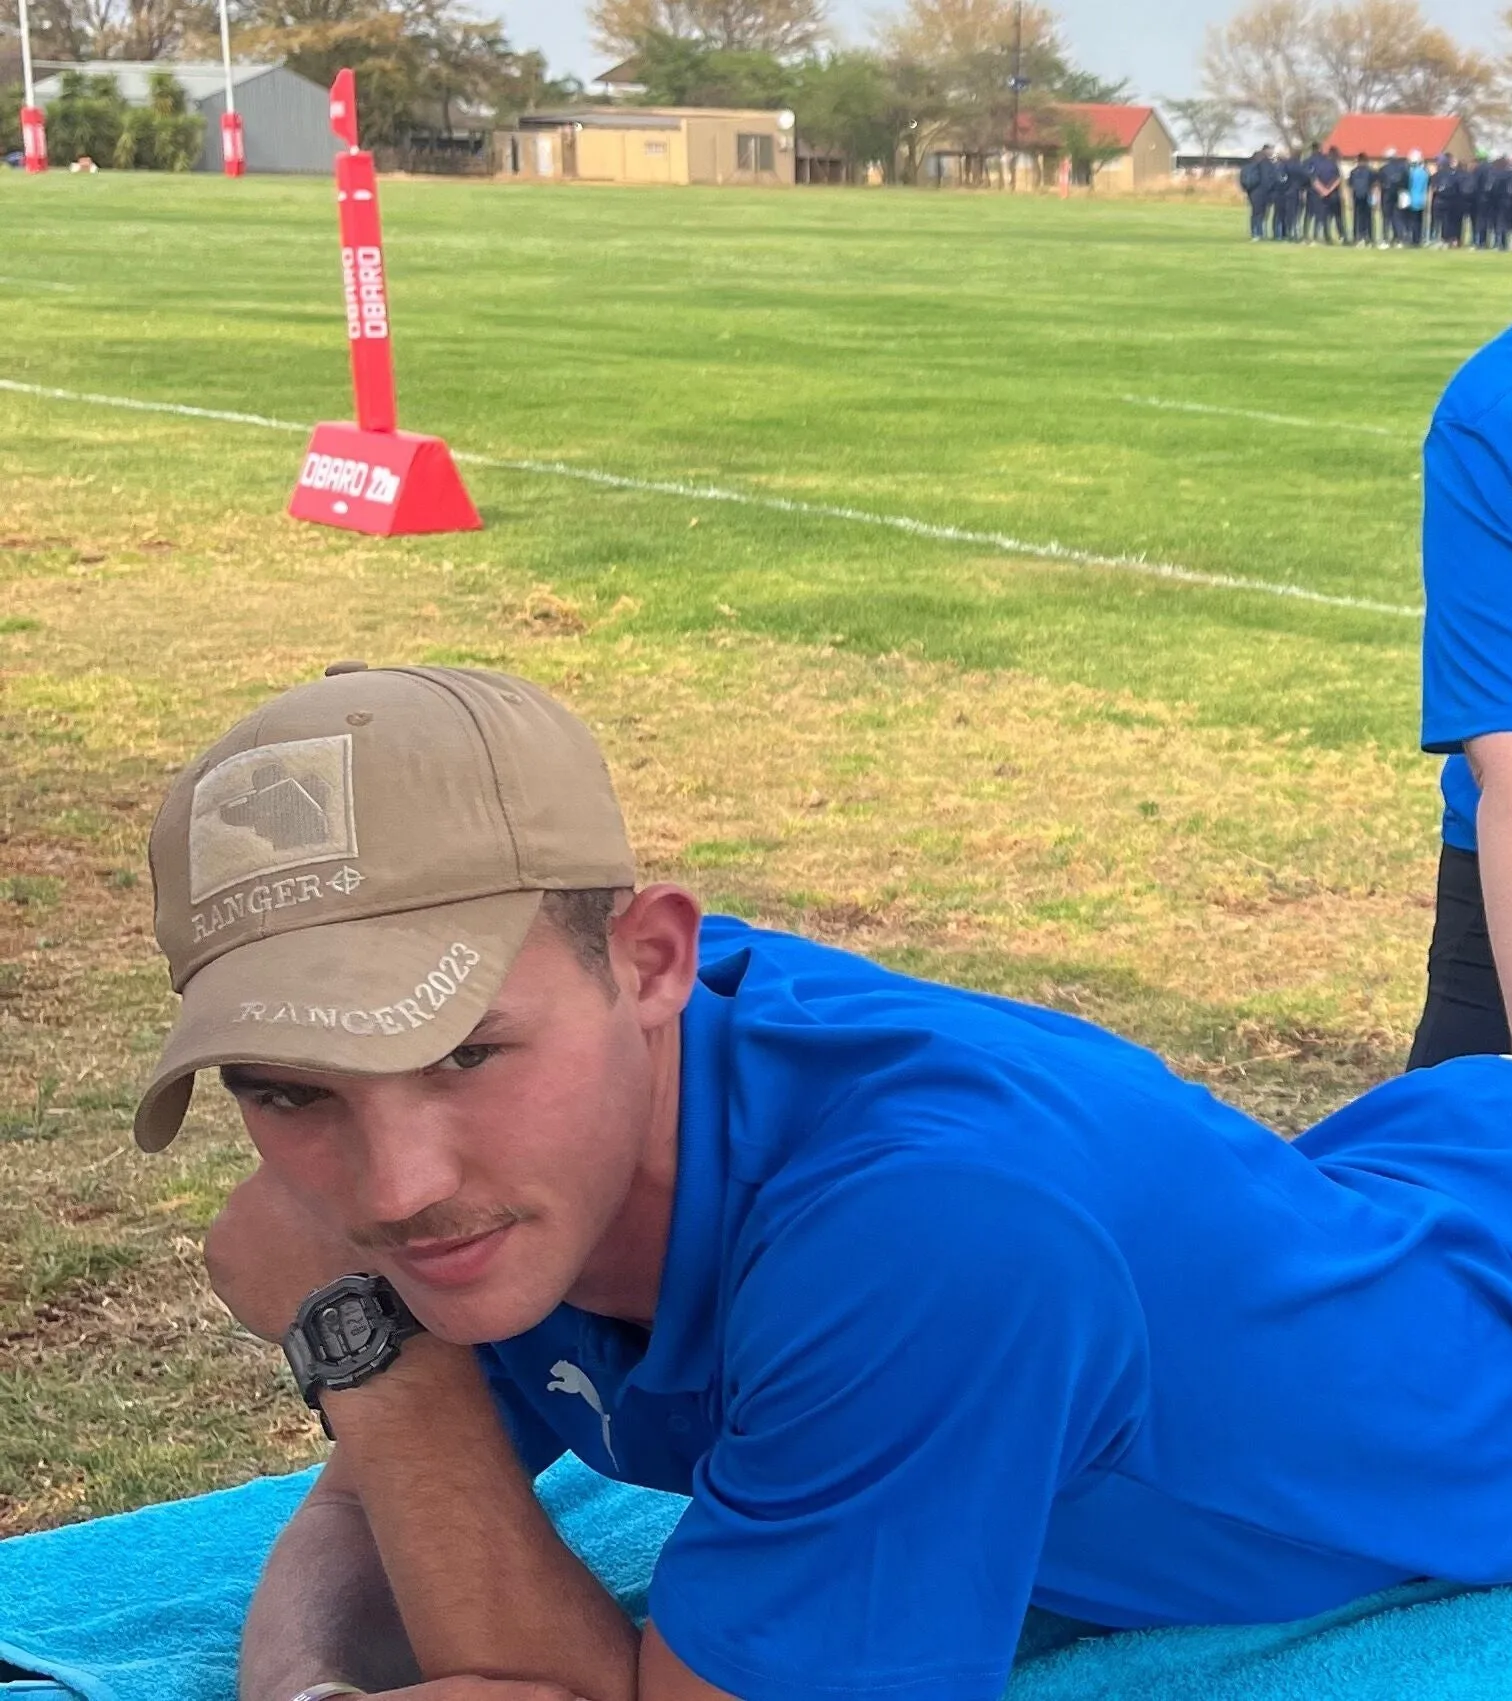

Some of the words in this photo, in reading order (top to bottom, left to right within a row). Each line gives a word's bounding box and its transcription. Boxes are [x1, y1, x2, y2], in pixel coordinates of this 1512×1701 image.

[358, 246, 388, 338] OBARO
[301, 452, 369, 497] OBARO
[191, 874, 324, 943] RANGER
